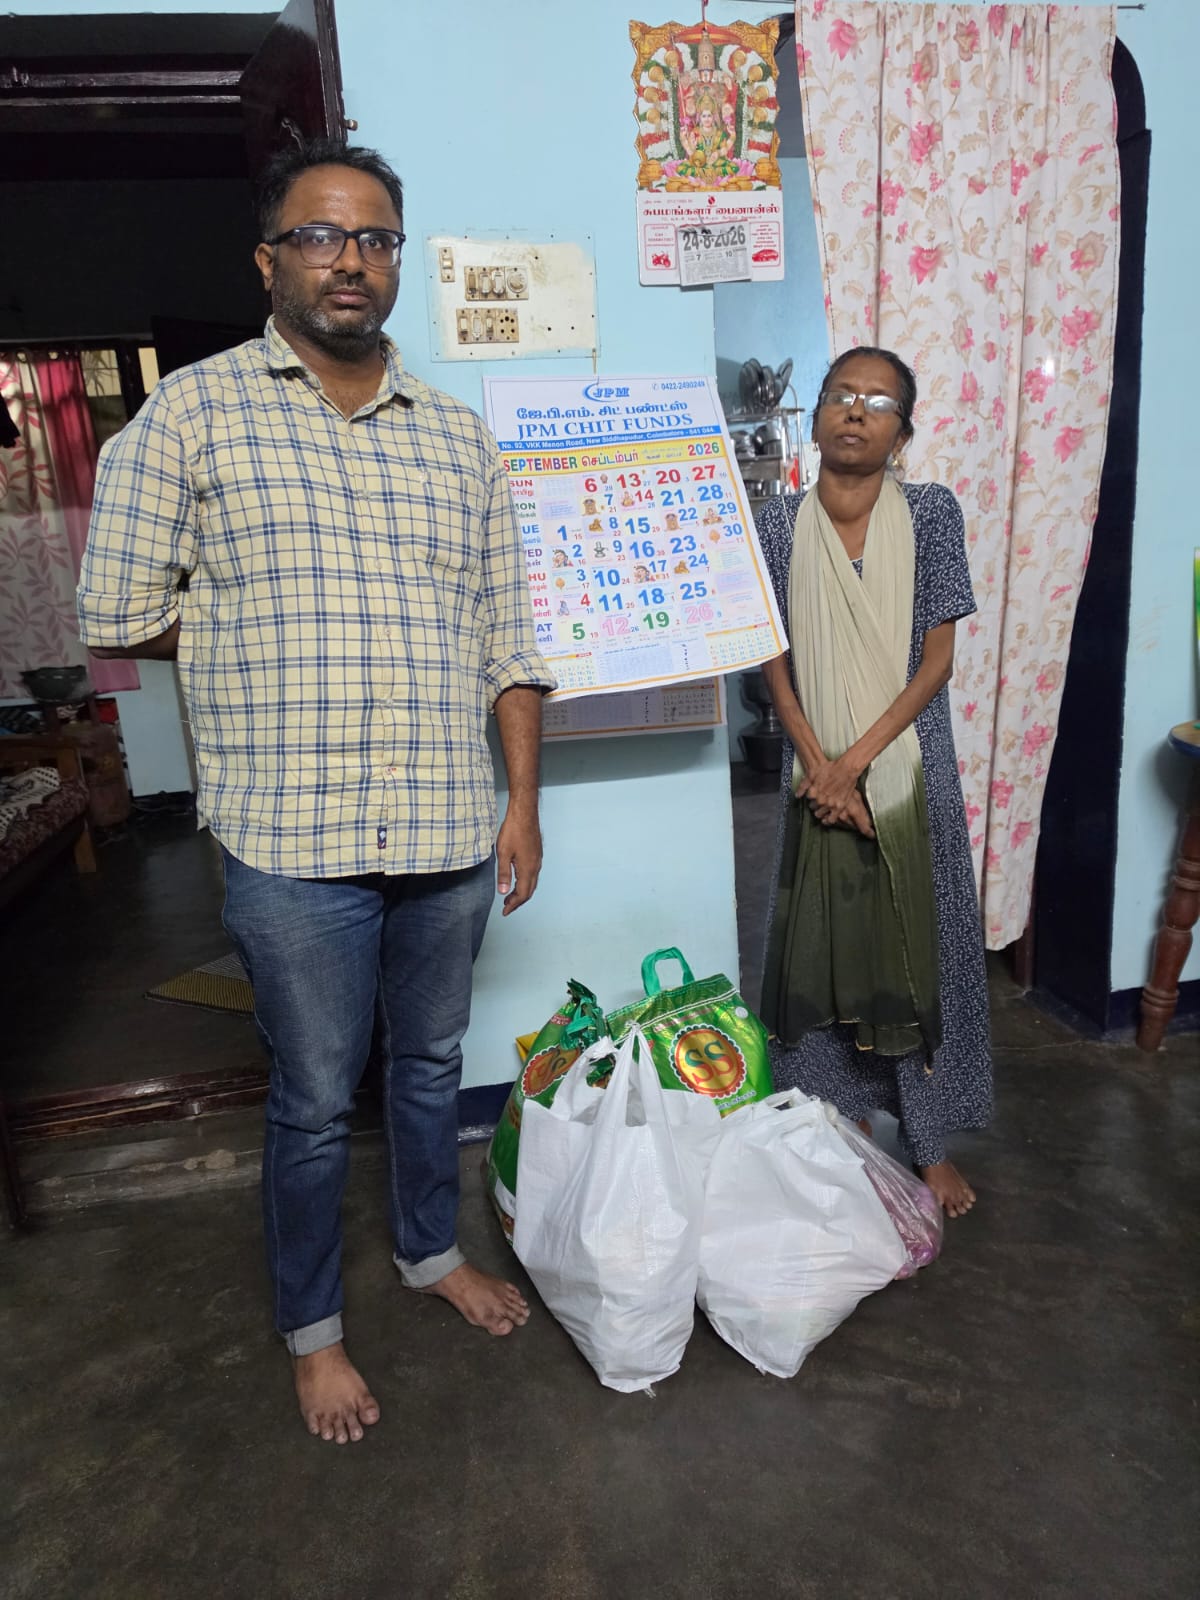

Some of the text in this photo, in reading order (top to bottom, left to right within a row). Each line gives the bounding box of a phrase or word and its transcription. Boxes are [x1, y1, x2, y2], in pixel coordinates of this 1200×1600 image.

[598, 405, 621, 416] சிட்
[517, 413, 694, 440] JPM CHIT FUNDS
[581, 449, 639, 467] செப்டம்பர்
[687, 442, 720, 457] 2026
[503, 456, 578, 472] SEPTEMBER
[509, 479, 533, 487] SUN
[584, 477, 598, 492] 6
[616, 473, 641, 488] 13
[656, 469, 681, 485] 20
[692, 464, 716, 481] 27
[604, 494, 613, 506] 7
[634, 489, 654, 502] 14
[660, 489, 685, 507] 21
[697, 484, 724, 502] 28
[522, 524, 540, 534] UE
[557, 525, 567, 541] 1
[609, 517, 618, 529] 8
[625, 516, 650, 535] 15
[678, 507, 698, 522] 22
[717, 502, 737, 515] 29
[525, 548, 542, 557] ED
[572, 544, 582, 558] 2
[612, 540, 622, 553] 9
[629, 540, 655, 559] 16
[670, 535, 696, 554] 23
[723, 523, 742, 537] 30
[528, 572, 546, 581] HU
[576, 569, 586, 581] 3
[594, 569, 620, 588] 10
[649, 560, 667, 573] 17
[688, 553, 708, 567] 24
[533, 597, 548, 607] RI
[580, 593, 591, 606] 4
[598, 593, 623, 612] 11
[638, 588, 665, 606] 18
[680, 581, 707, 600] 25
[536, 623, 552, 633] AT
[572, 622, 585, 640] 5
[602, 617, 631, 637] 12
[643, 611, 670, 630] 19
[685, 603, 714, 624] 26
[685, 1040, 733, 1085] SS
